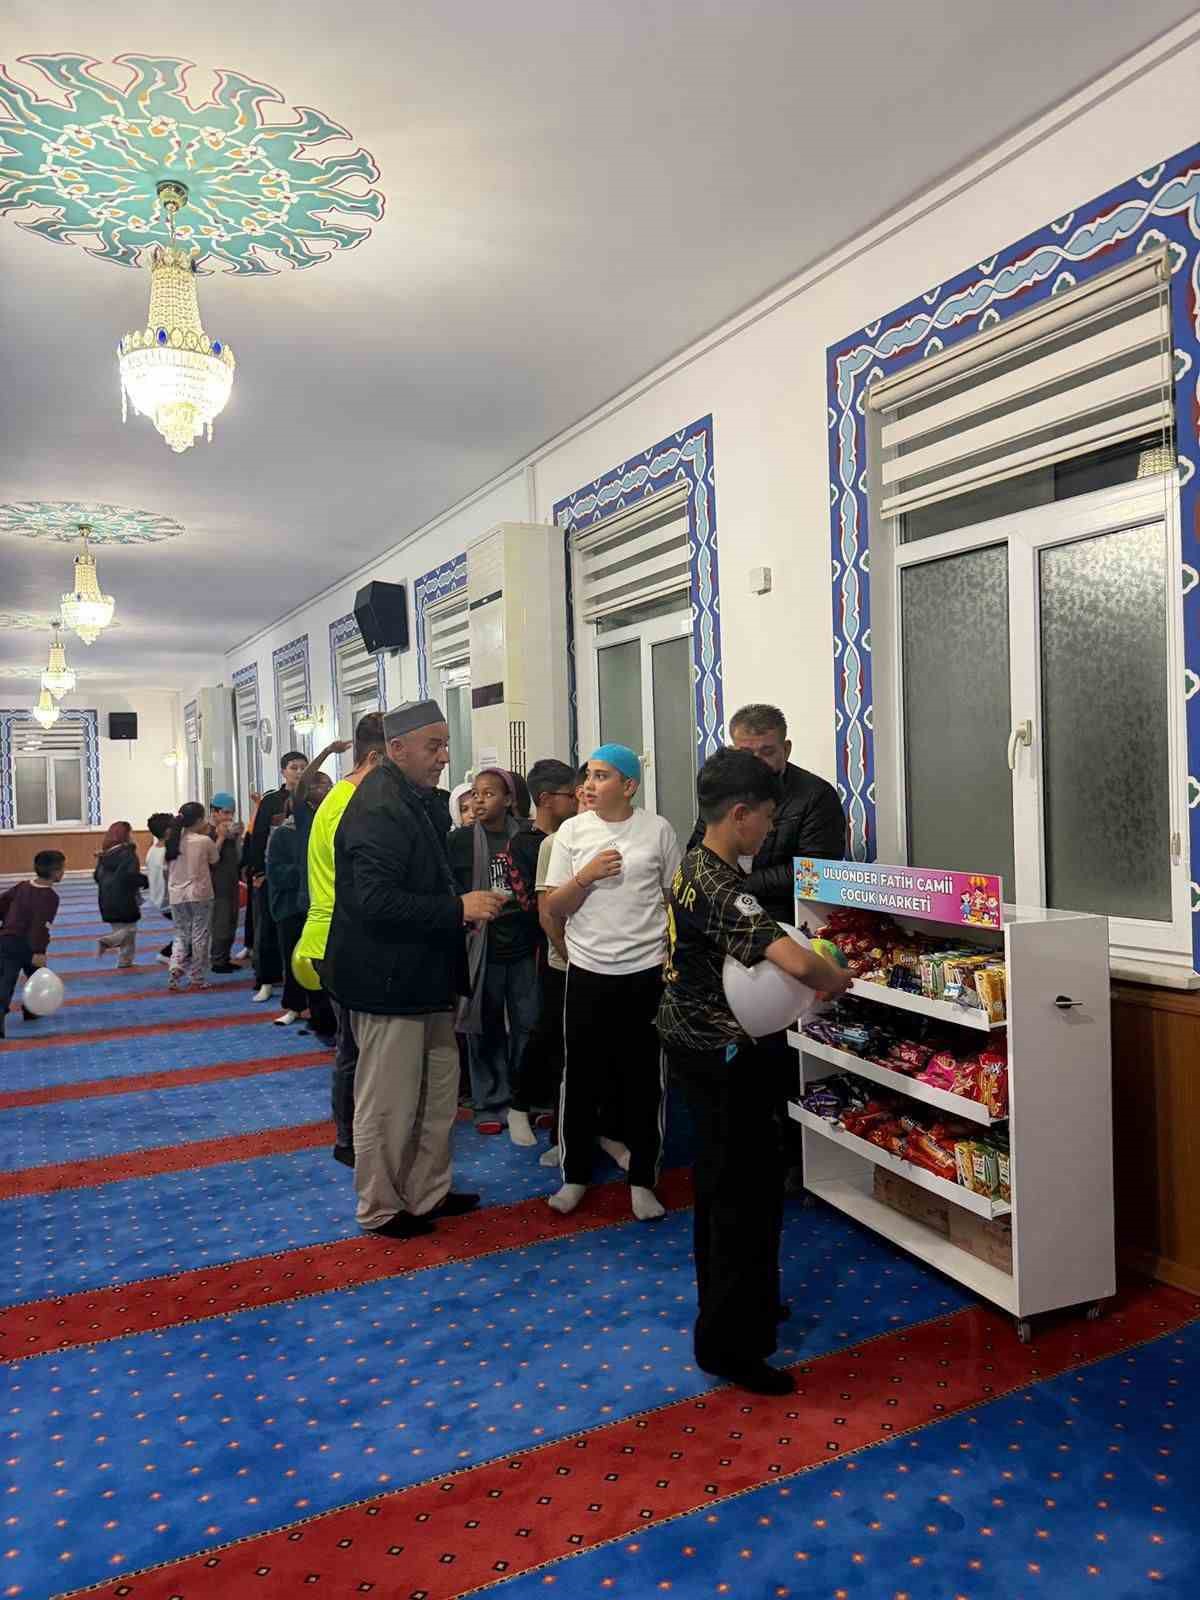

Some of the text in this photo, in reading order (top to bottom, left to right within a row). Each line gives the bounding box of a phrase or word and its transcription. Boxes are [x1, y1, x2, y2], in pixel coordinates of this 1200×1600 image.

[880, 871, 914, 889] FATİH
[916, 876, 953, 895] CAMİİ
[840, 887, 932, 912] ÇOCUK MARKETİ
